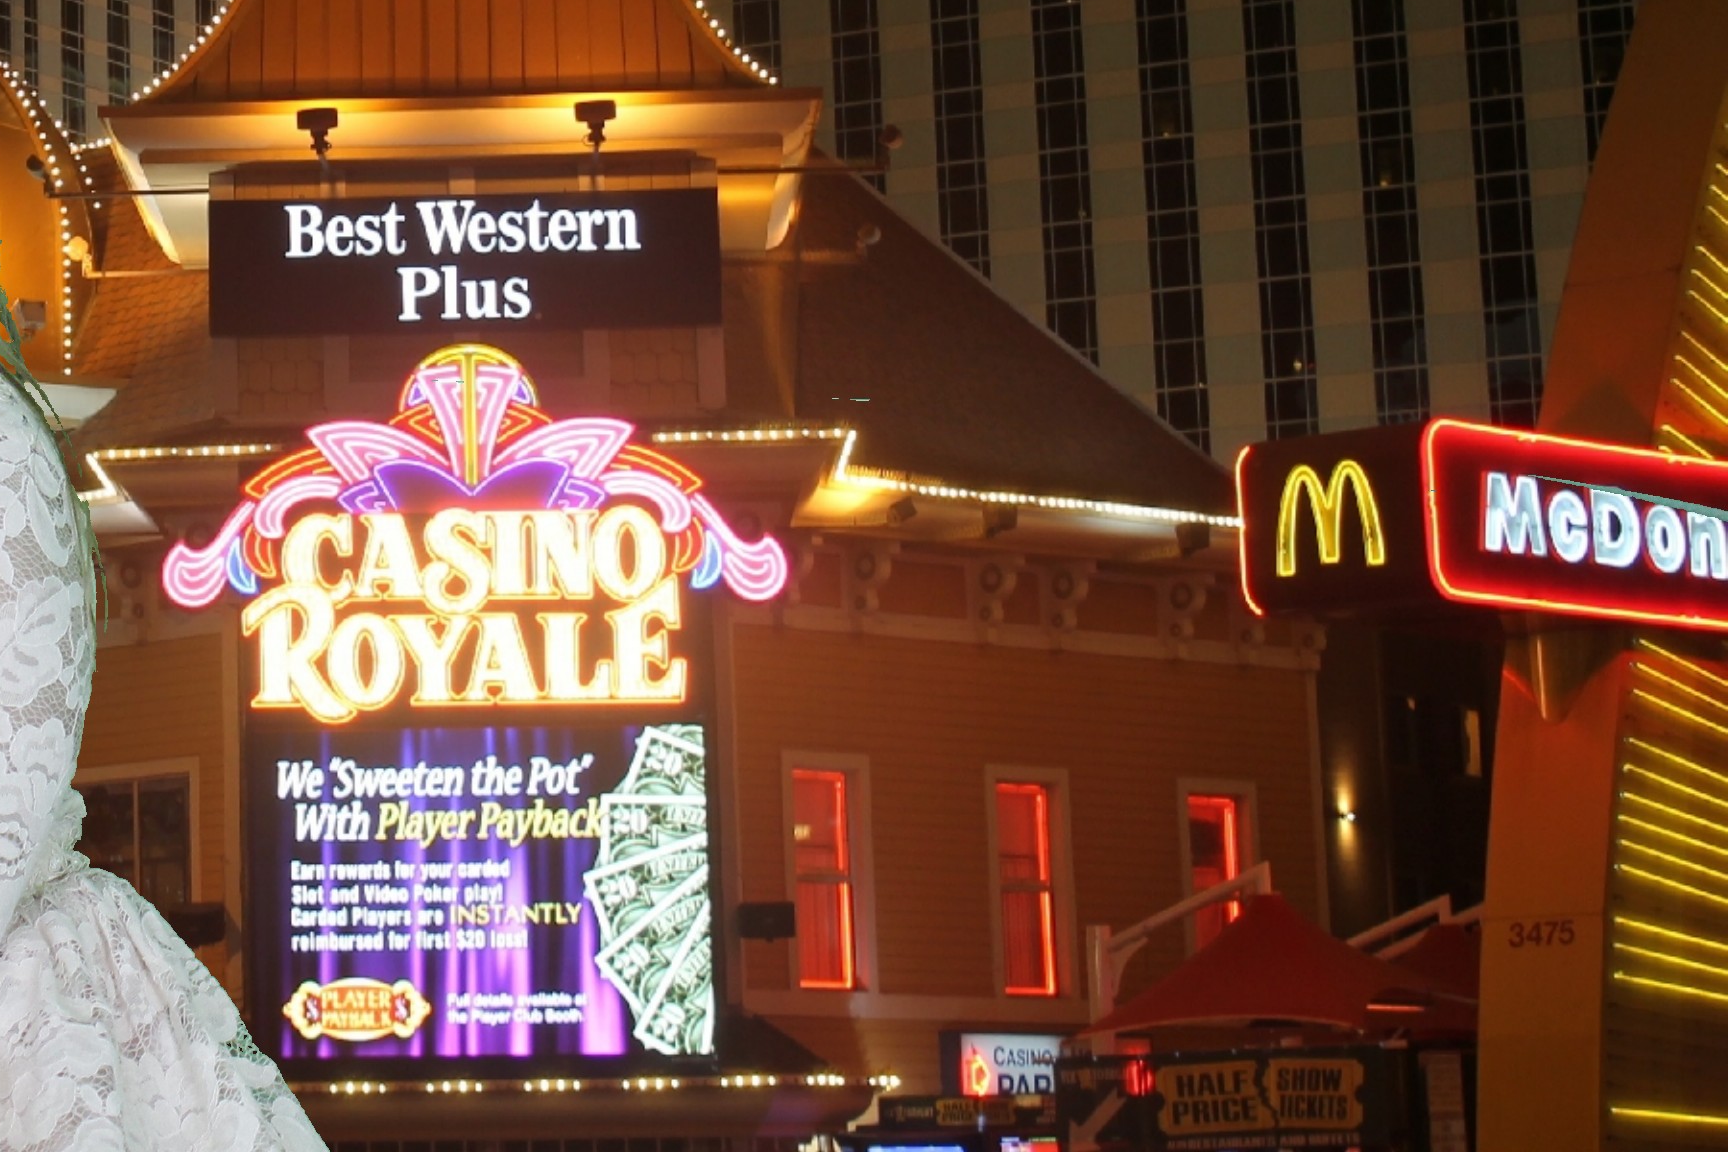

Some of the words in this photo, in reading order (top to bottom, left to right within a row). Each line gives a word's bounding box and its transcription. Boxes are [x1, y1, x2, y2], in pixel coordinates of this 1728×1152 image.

[284, 202, 407, 259] Best
[416, 199, 642, 255] Western
[397, 266, 533, 322] Plus
[281, 505, 665, 615] CASINO
[242, 576, 687, 723] ROYALE
[276, 760, 325, 799] We
[471, 755, 522, 796] the
[295, 802, 371, 841] With
[374, 801, 475, 850] Player
[477, 798, 602, 848] Payback
[290, 860, 325, 880] Earn
[330, 860, 391, 880] rewards
[395, 860, 416, 880] for
[420, 862, 454, 883] your
[457, 858, 511, 879] carded
[290, 884, 325, 905] Slot
[329, 884, 360, 904] and
[364, 884, 409, 905] Video
[414, 884, 459, 904] Poker
[464, 883, 504, 906] play!
[290, 906, 348, 927] Carded
[351, 906, 412, 929] Players
[417, 908, 445, 927] are
[450, 902, 583, 926] INSTANTLY
[290, 931, 384, 952] reimbursed
[388, 931, 411, 951] for
[415, 930, 450, 950] first
[456, 928, 486, 952] $20
[1508, 919, 1575, 948] 3475
[321, 990, 391, 1008] PLAYER
[447, 1008, 468, 1024] the
[472, 1008, 511, 1027] Player
[993, 1045, 1053, 1067] CASINO
[1176, 1070, 1249, 1097] HALF
[1277, 1066, 1343, 1092] SHOW
[1173, 1097, 1258, 1125] PRICE
[1279, 1094, 1348, 1120] TICKETS
